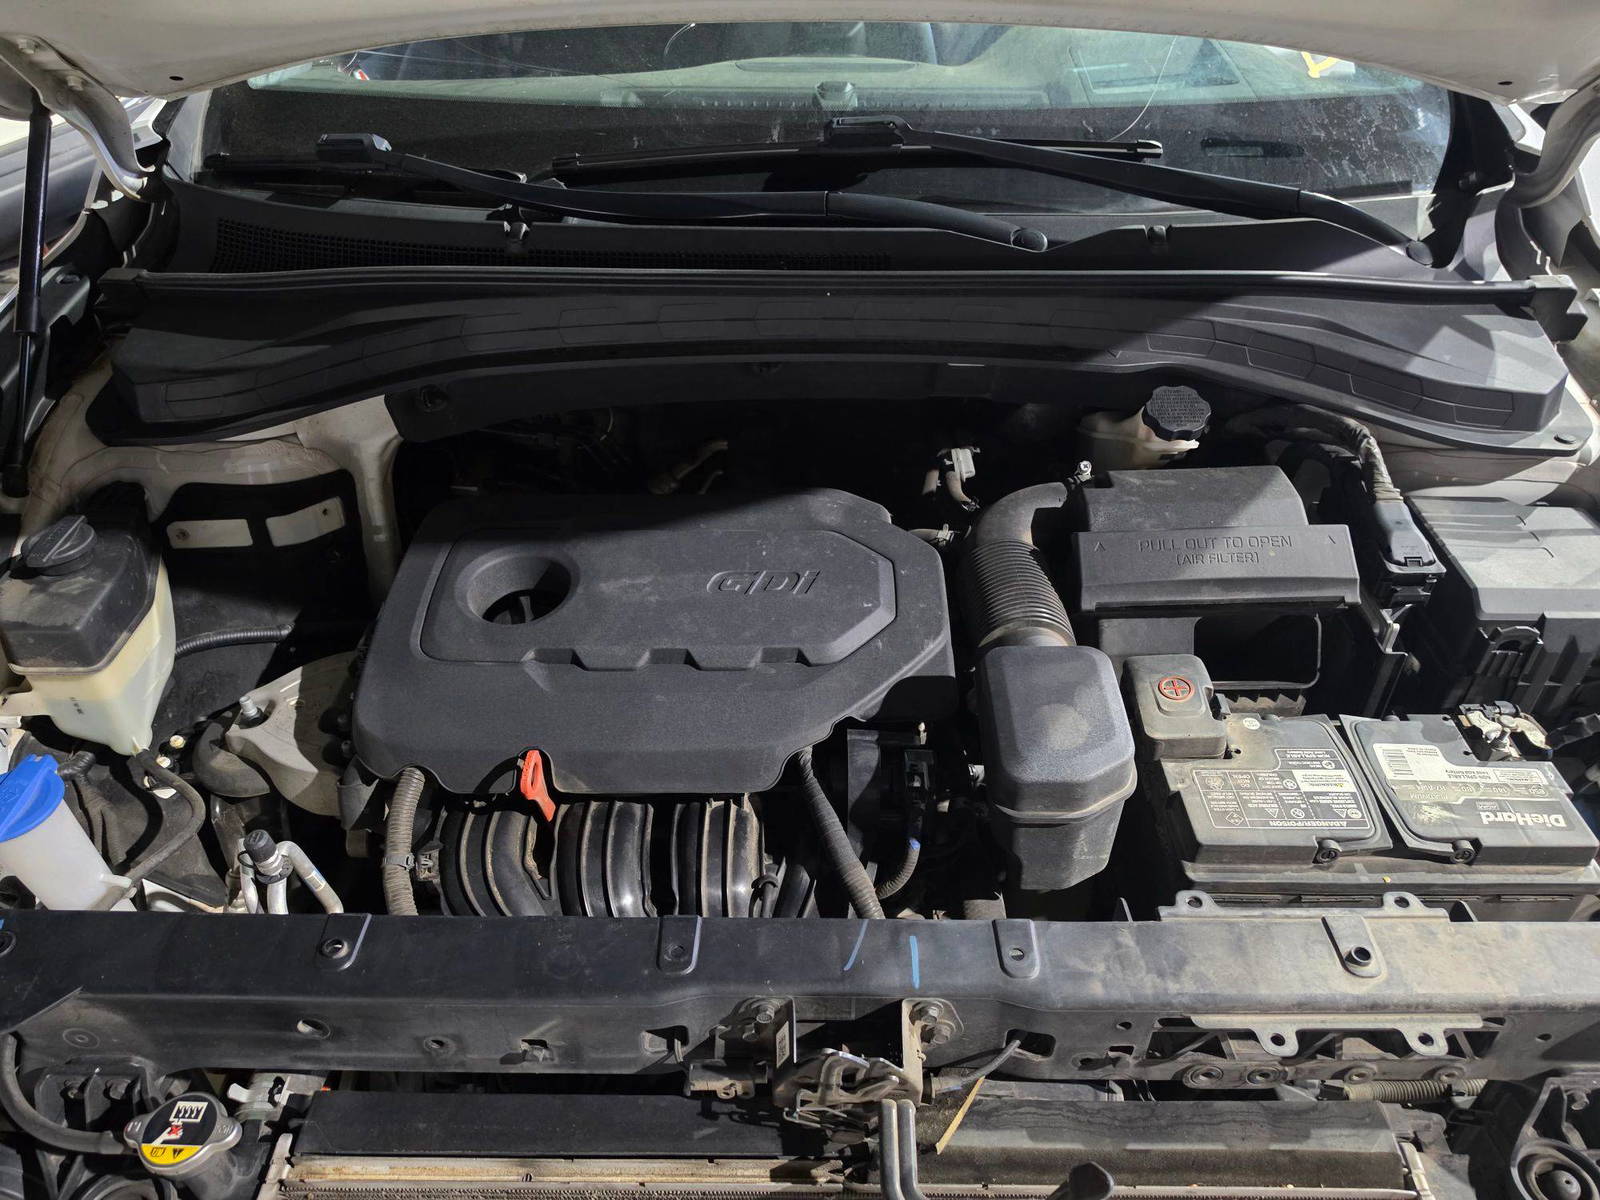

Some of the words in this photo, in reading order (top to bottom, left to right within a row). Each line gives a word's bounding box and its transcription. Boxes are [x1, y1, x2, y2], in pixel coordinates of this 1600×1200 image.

[1138, 538, 1181, 552] PULL
[1184, 537, 1217, 550] OUT
[1223, 536, 1244, 549] TO
[1248, 535, 1293, 548] OPEN
[1480, 811, 1567, 827] DieHard
